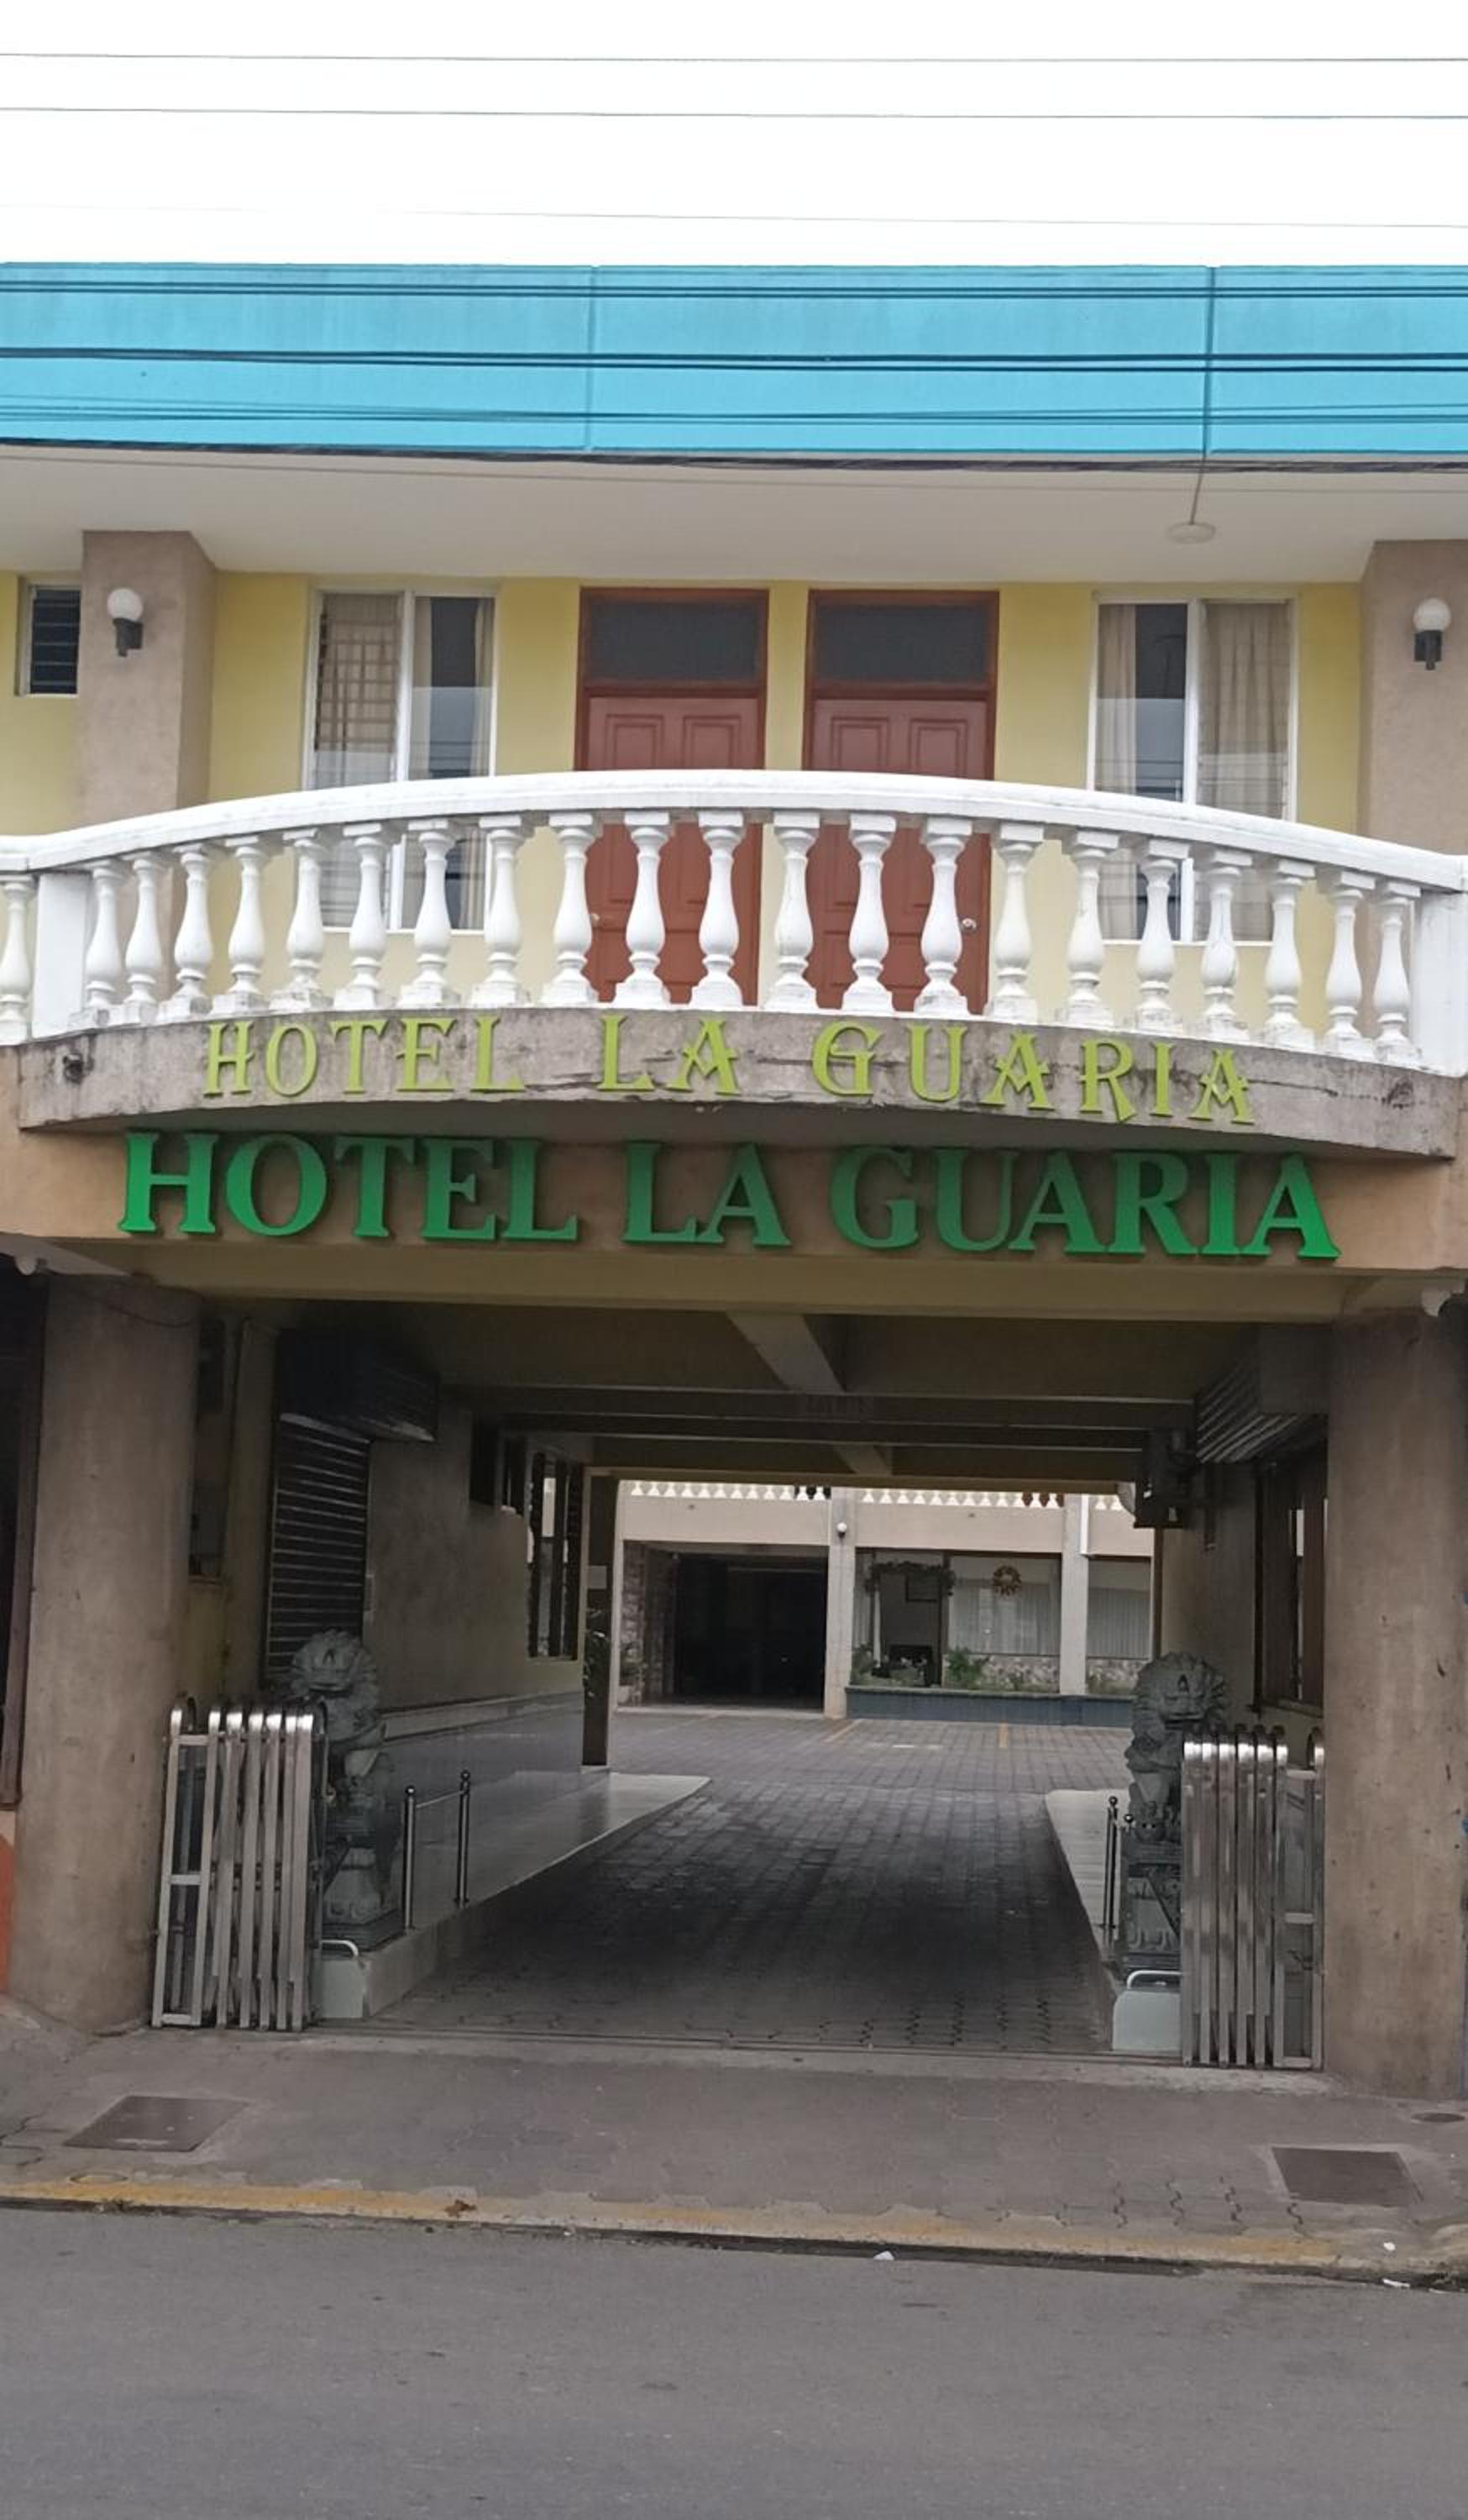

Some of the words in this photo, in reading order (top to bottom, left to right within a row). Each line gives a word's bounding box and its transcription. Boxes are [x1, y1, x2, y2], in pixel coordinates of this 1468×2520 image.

[203, 1014, 527, 1097] HOTEL
[597, 1014, 742, 1095] LA
[811, 1020, 1256, 1124] GUARIA
[118, 1131, 579, 1241] HOTEL
[623, 1141, 792, 1247] LA
[829, 1145, 1342, 1260] GUARIA
